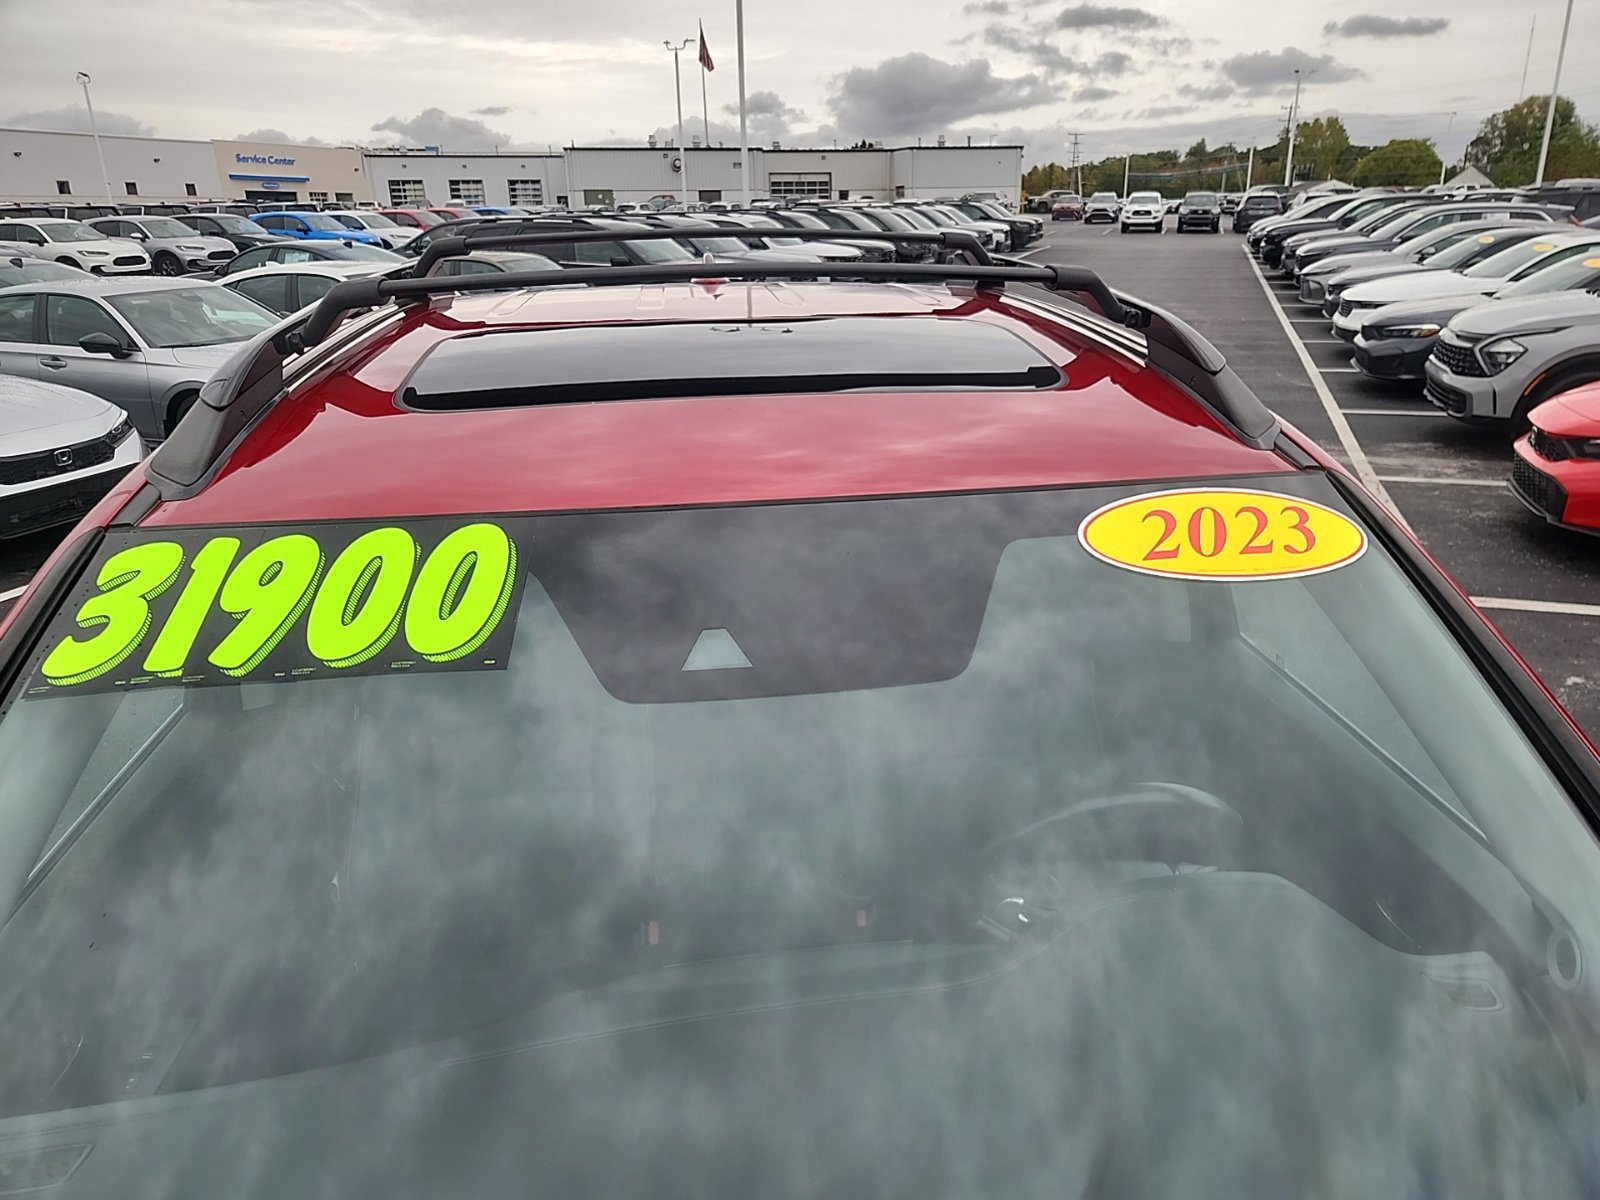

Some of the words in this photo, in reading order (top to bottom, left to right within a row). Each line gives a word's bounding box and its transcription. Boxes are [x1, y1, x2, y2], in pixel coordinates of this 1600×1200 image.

[235, 153, 266, 164] Service
[267, 155, 296, 166] Center
[1141, 506, 1316, 561] 2023
[41, 523, 517, 686] 31900
